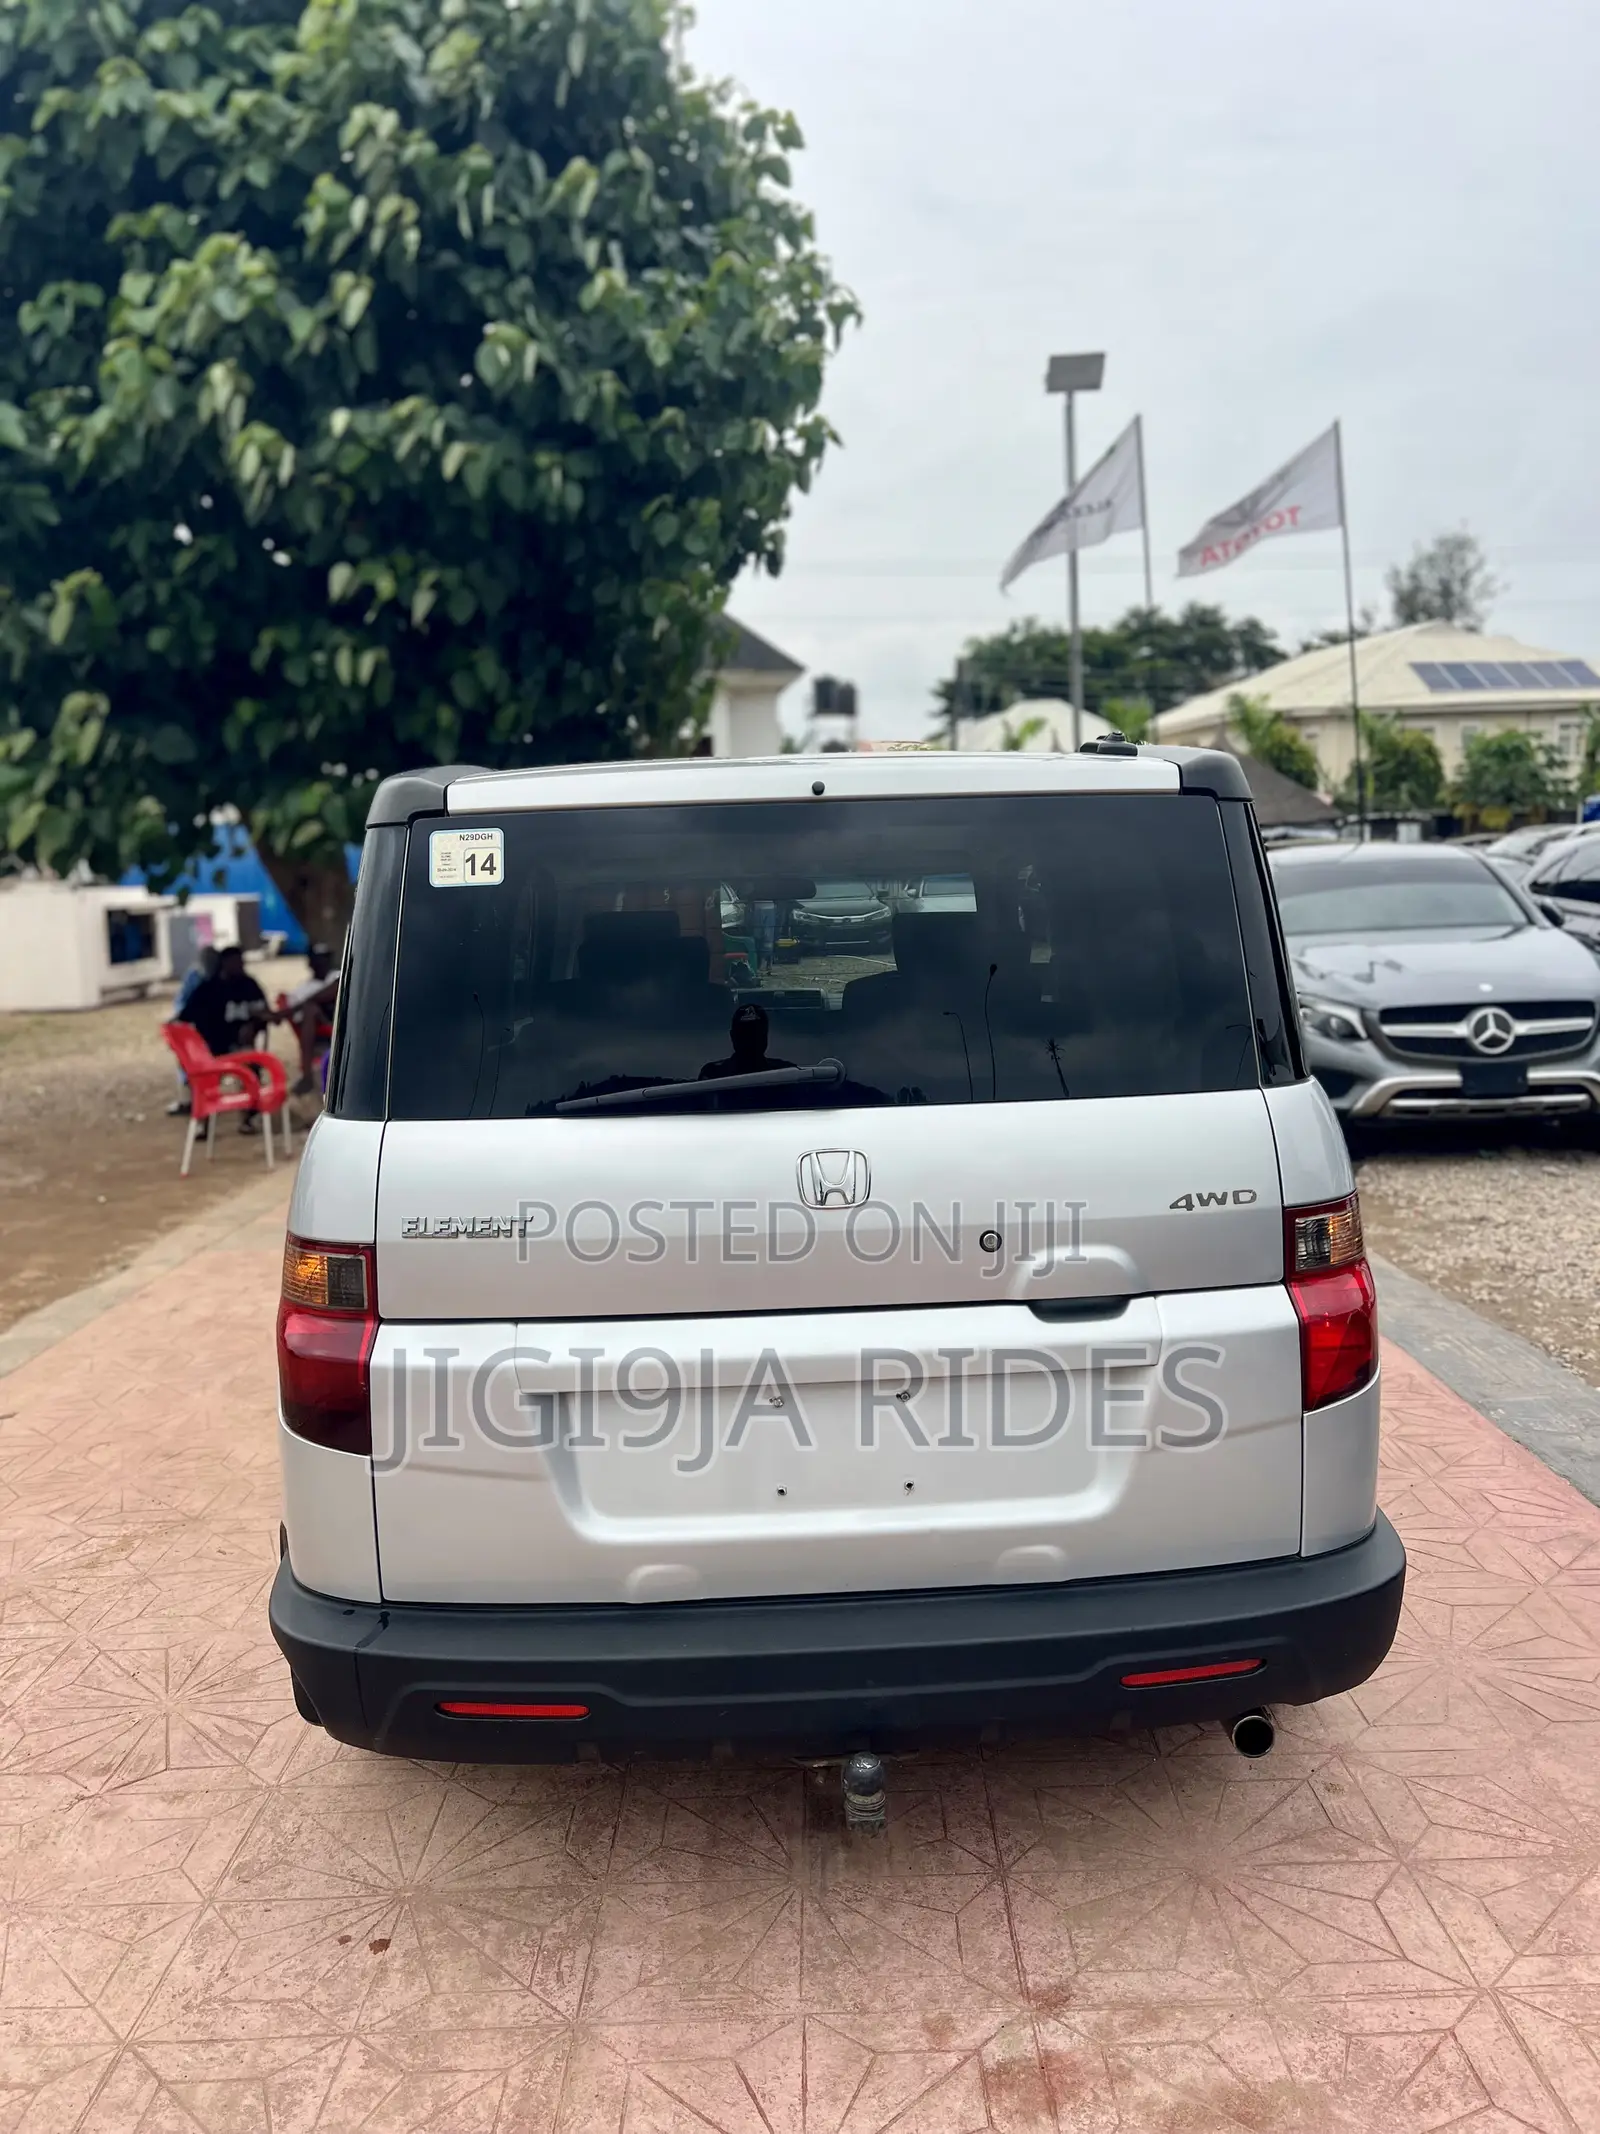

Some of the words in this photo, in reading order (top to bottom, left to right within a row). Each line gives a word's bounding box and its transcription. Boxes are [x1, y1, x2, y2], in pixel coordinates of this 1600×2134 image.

[465, 852, 497, 876] 14
[1169, 1187, 1258, 1212] 4WD
[401, 1214, 534, 1239] ELEMENT
